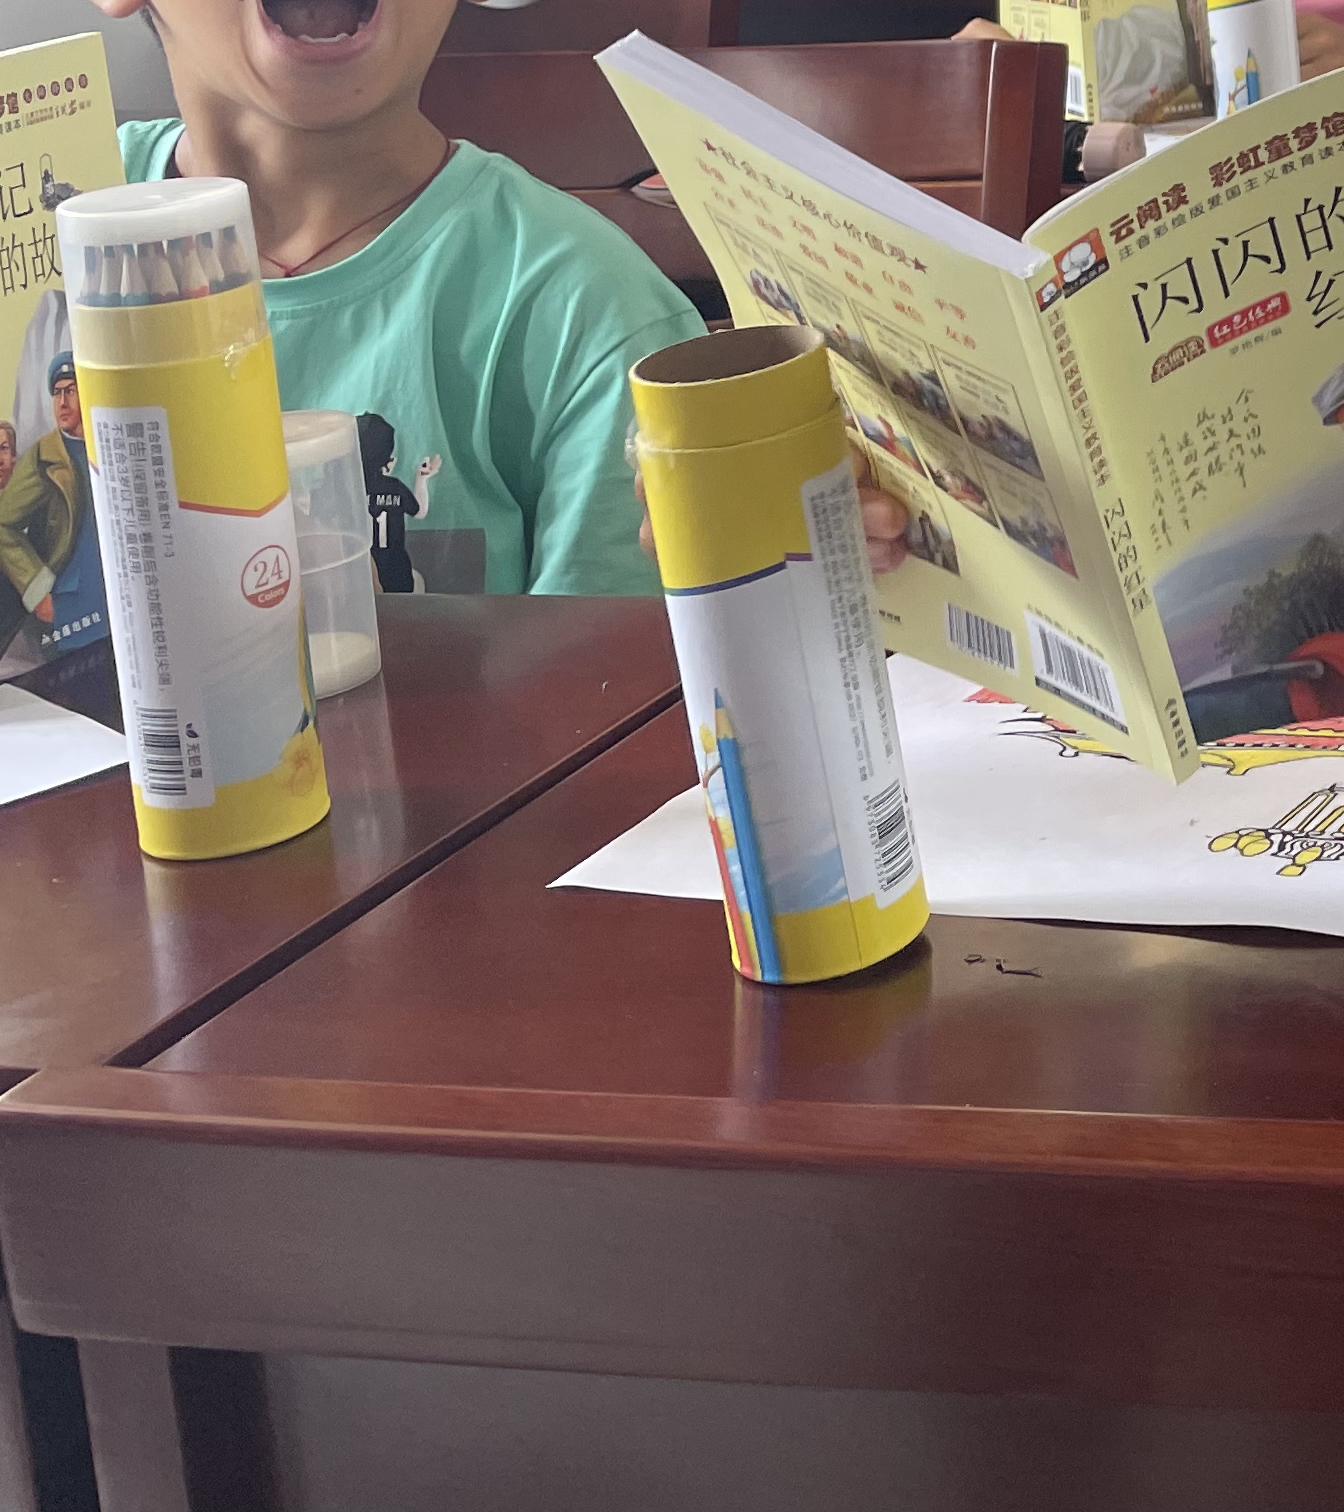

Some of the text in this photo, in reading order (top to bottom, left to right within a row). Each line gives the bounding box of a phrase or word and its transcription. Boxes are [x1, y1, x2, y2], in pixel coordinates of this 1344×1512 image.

[1109, 182, 1190, 246] 云阅读
[375, 493, 402, 507] MAN
[253, 554, 285, 589] 24
[257, 587, 286, 603] Colors
